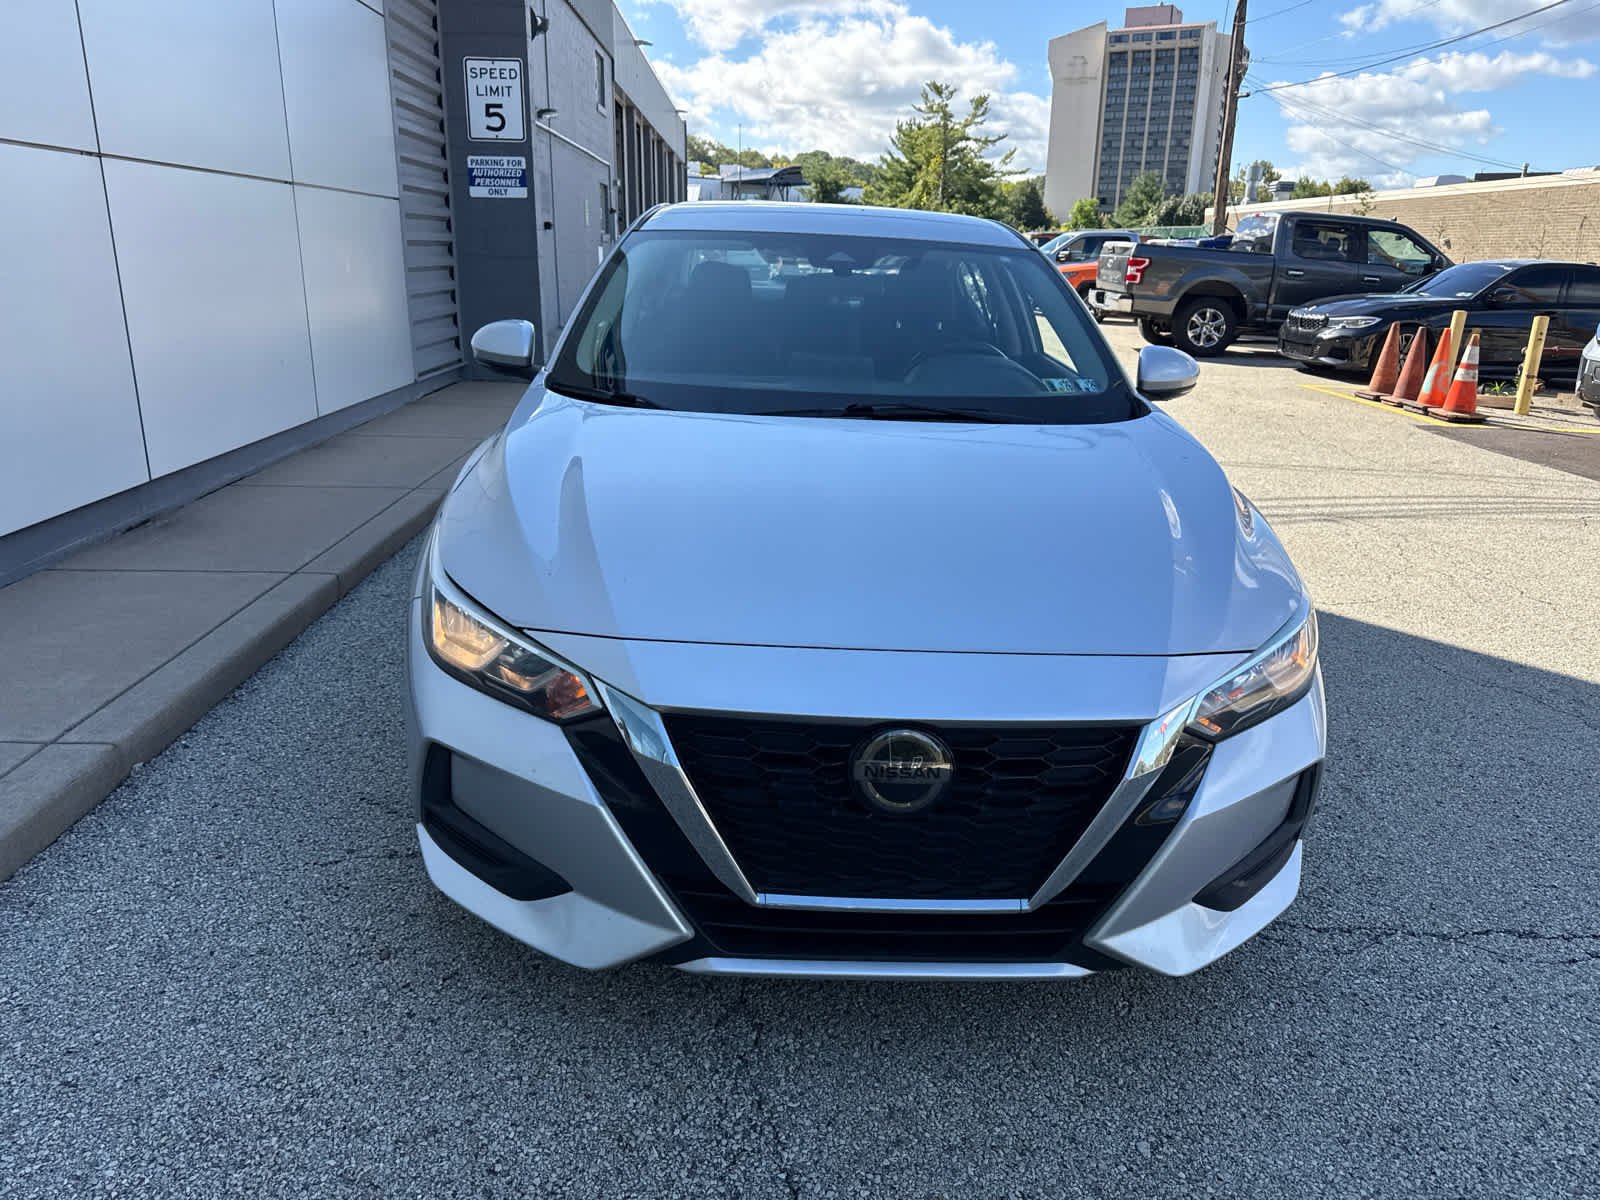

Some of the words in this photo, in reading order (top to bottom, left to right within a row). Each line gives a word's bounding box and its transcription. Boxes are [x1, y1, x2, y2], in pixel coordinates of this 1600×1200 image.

[469, 67, 518, 80] SPEED
[475, 85, 513, 97] LIMIT
[484, 103, 506, 132] 5
[470, 158, 504, 167] PARKING
[507, 159, 522, 167] FOR
[472, 168, 522, 177] AUTHORIZED
[475, 177, 521, 186] PERSONNEL
[488, 187, 508, 196] ONLY
[863, 764, 941, 779] NISSAN
